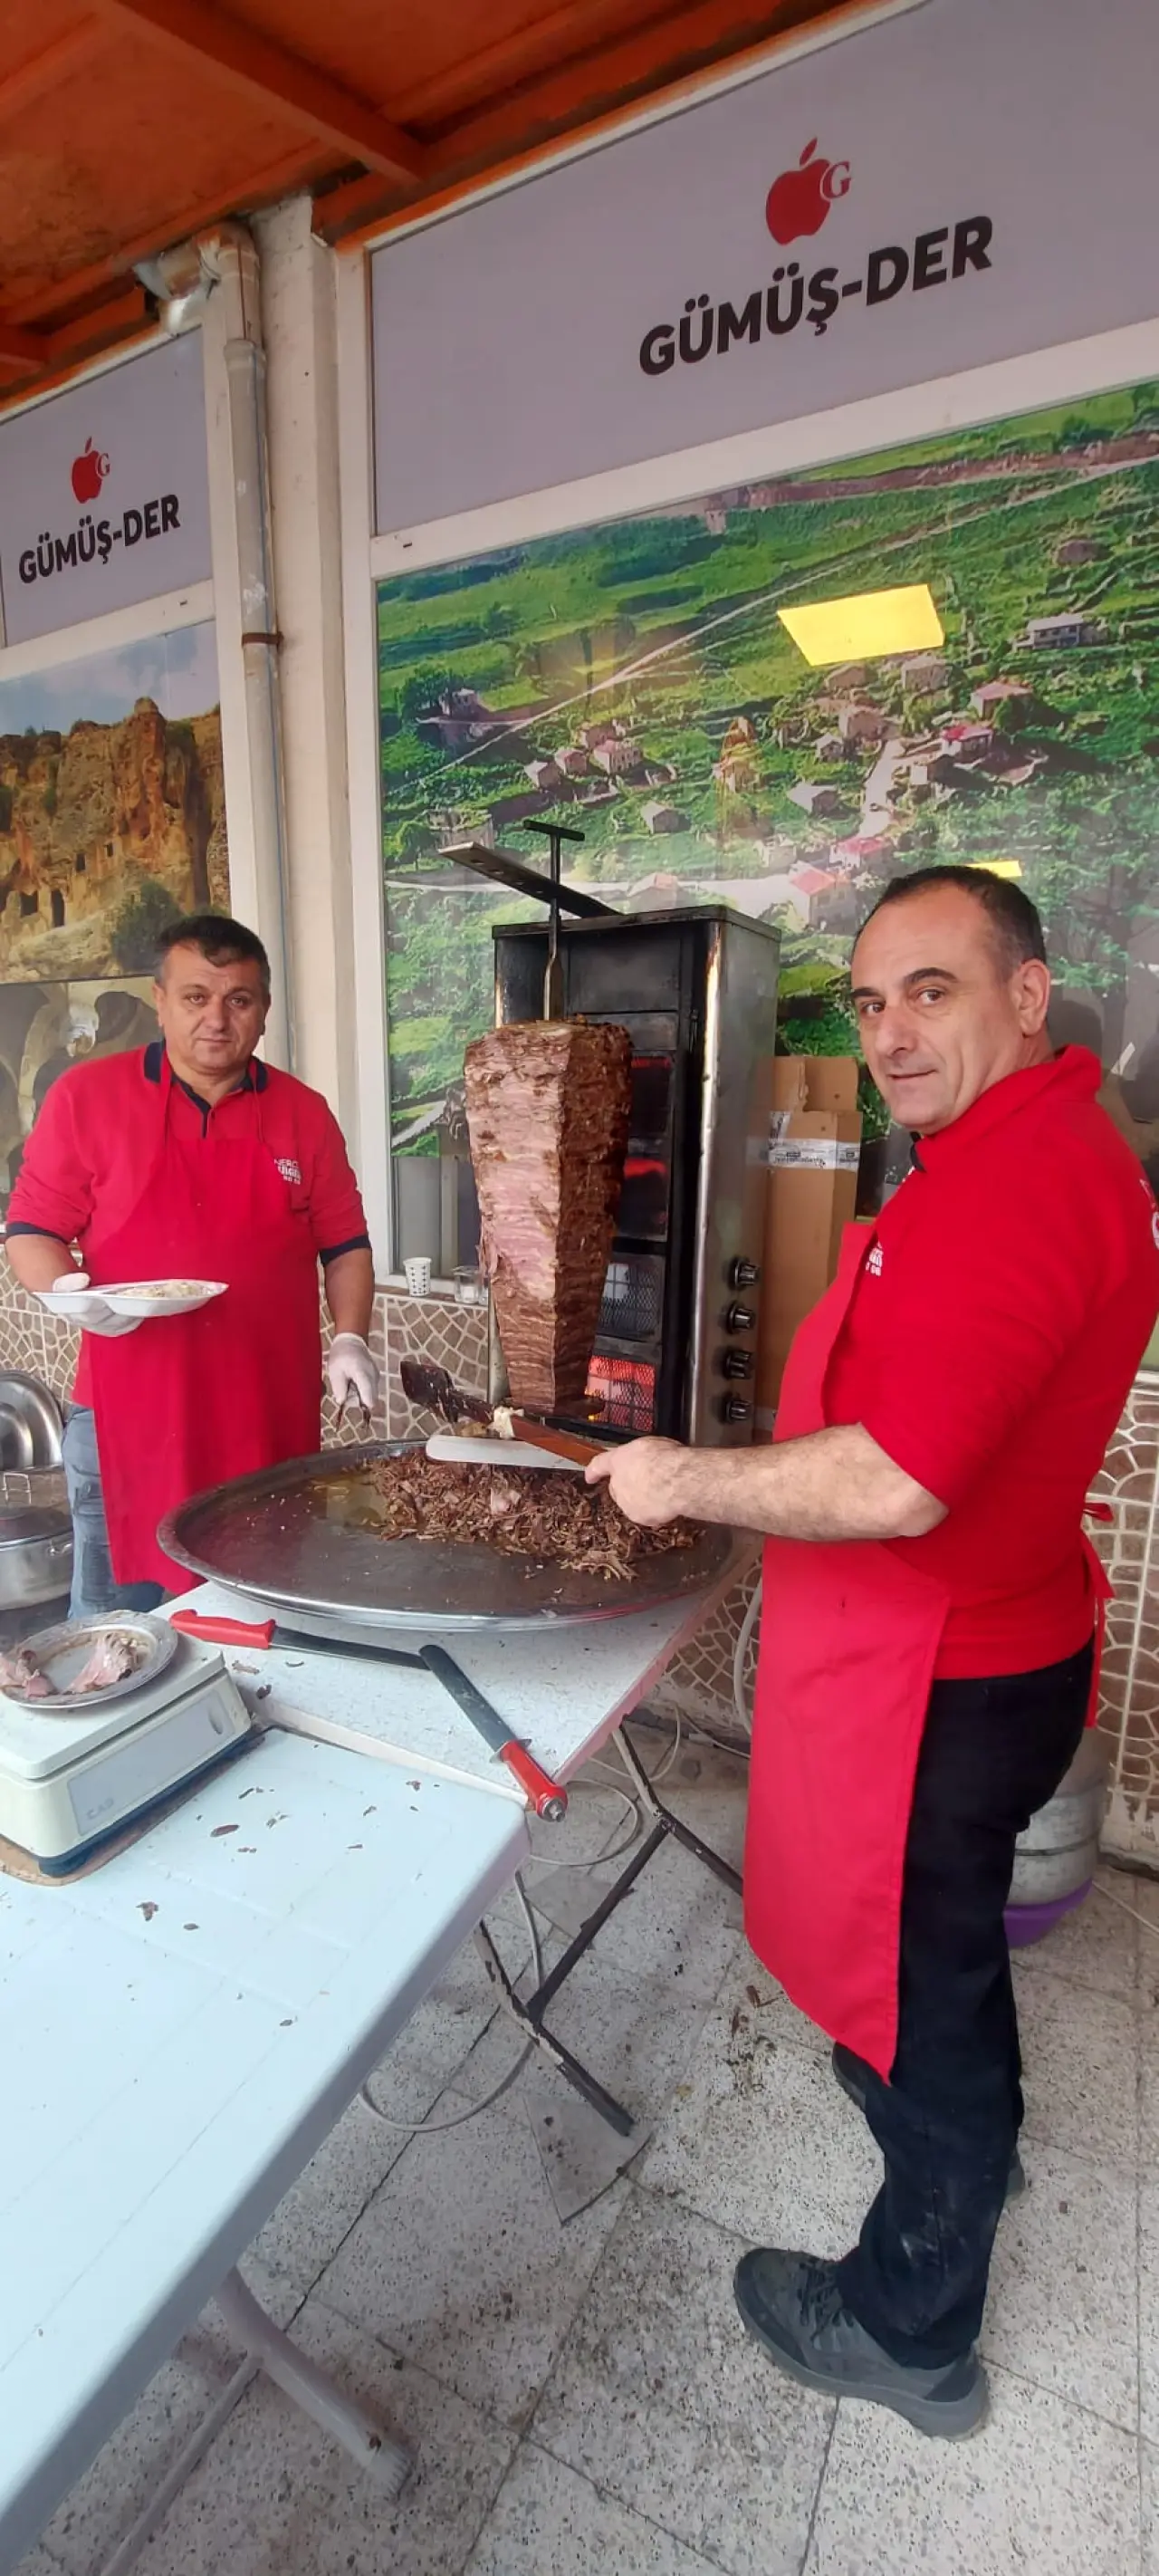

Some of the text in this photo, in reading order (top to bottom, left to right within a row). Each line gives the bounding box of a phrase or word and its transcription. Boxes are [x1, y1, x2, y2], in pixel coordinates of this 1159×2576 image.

[822, 161, 852, 199] G
[639, 216, 993, 375] GÜMÜŞ-DER
[97, 453, 110, 476] G
[19, 494, 181, 584] GÜMÜŞ-DER
